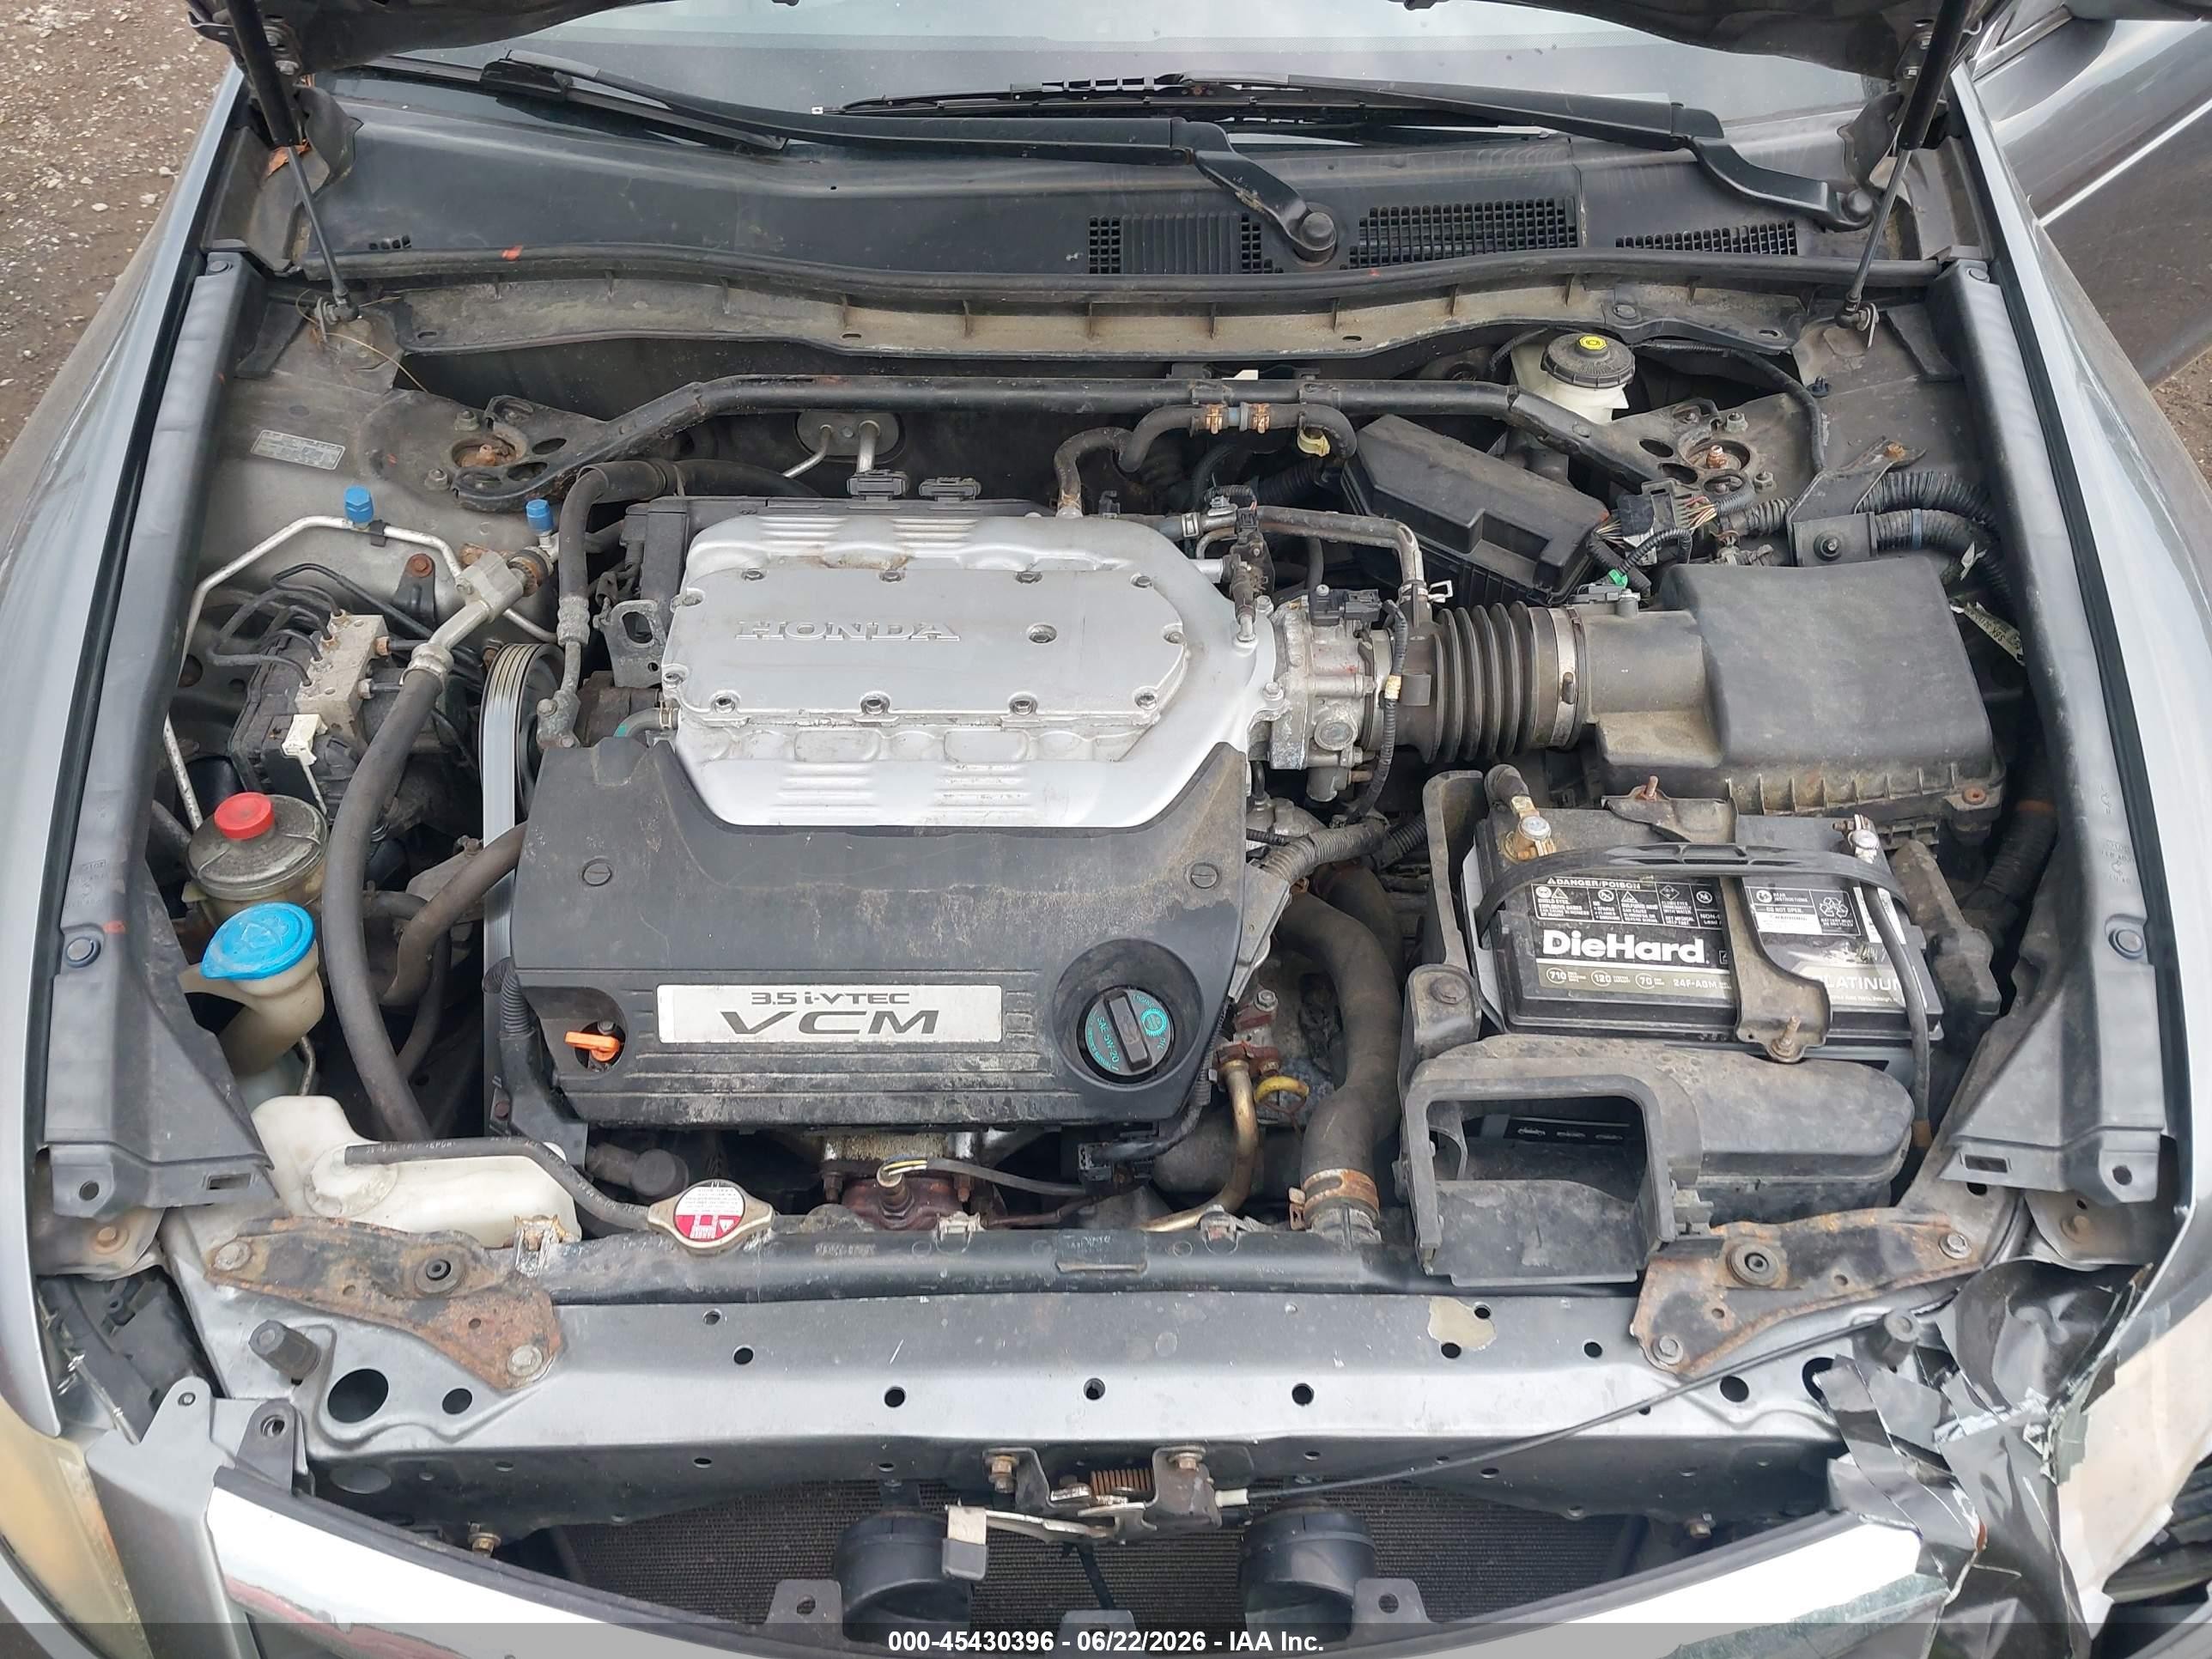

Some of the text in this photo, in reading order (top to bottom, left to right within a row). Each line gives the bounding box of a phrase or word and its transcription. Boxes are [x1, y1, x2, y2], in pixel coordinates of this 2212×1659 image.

[735, 621, 961, 641] HONDA
[1549, 970, 1566, 980] 710
[1594, 974, 1612, 983] 120
[1639, 976, 1653, 986] 70
[750, 992, 910, 1006] 3.5 i-VTEC
[720, 1011, 939, 1035] VCM
[1097, 1016, 1108, 1033] SAE
[1103, 1034, 1120, 1063] 5W-20
